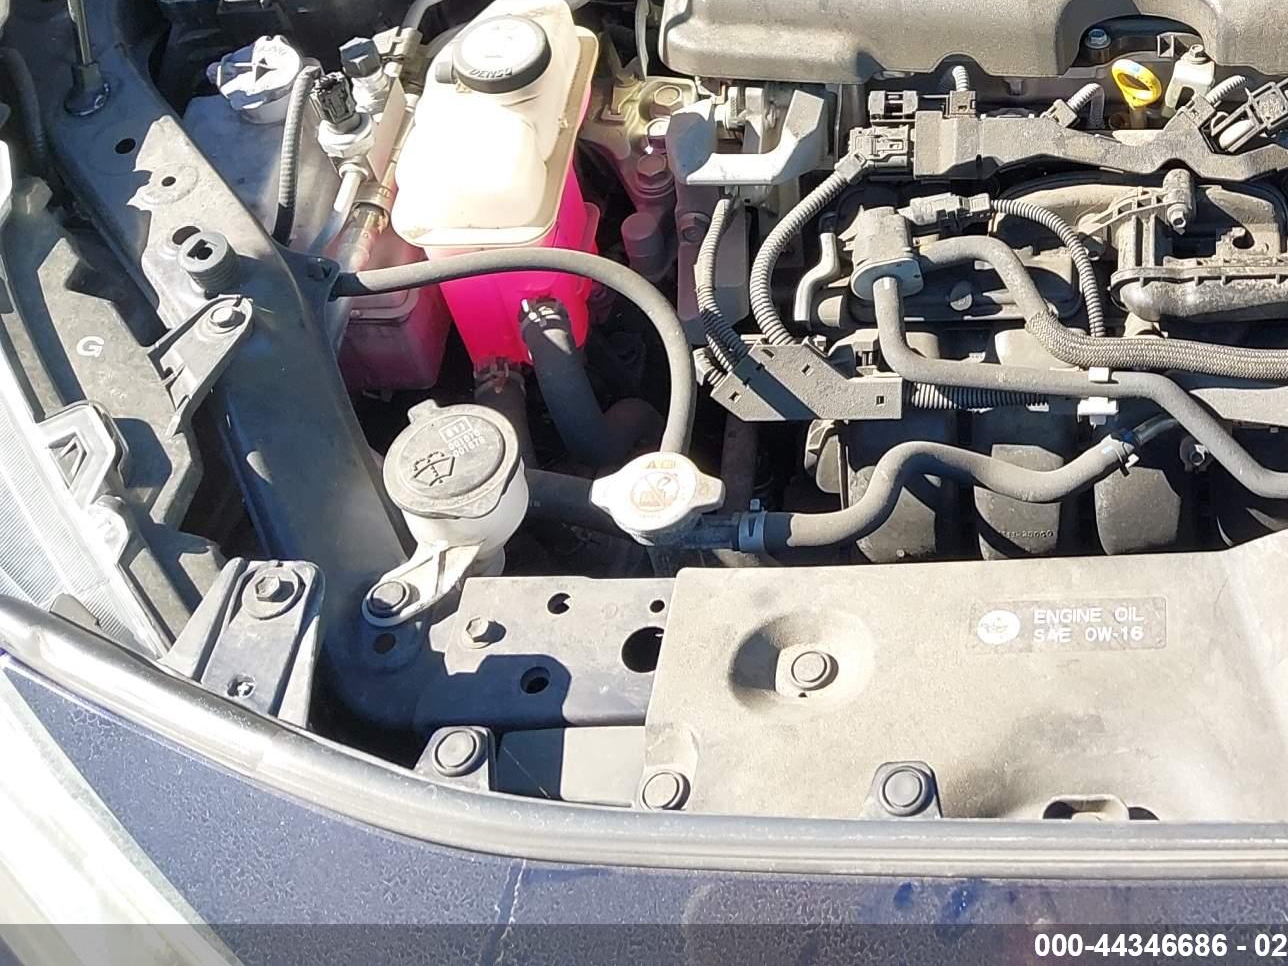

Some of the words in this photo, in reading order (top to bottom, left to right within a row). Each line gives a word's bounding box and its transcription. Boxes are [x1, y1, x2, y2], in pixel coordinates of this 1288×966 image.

[469, 67, 513, 79] DENSO
[76, 335, 105, 358] G
[1033, 608, 1102, 625] ENGINE
[1114, 607, 1145, 623] OIL
[1033, 627, 1072, 643] SAE
[1085, 625, 1145, 642] 0W-16
